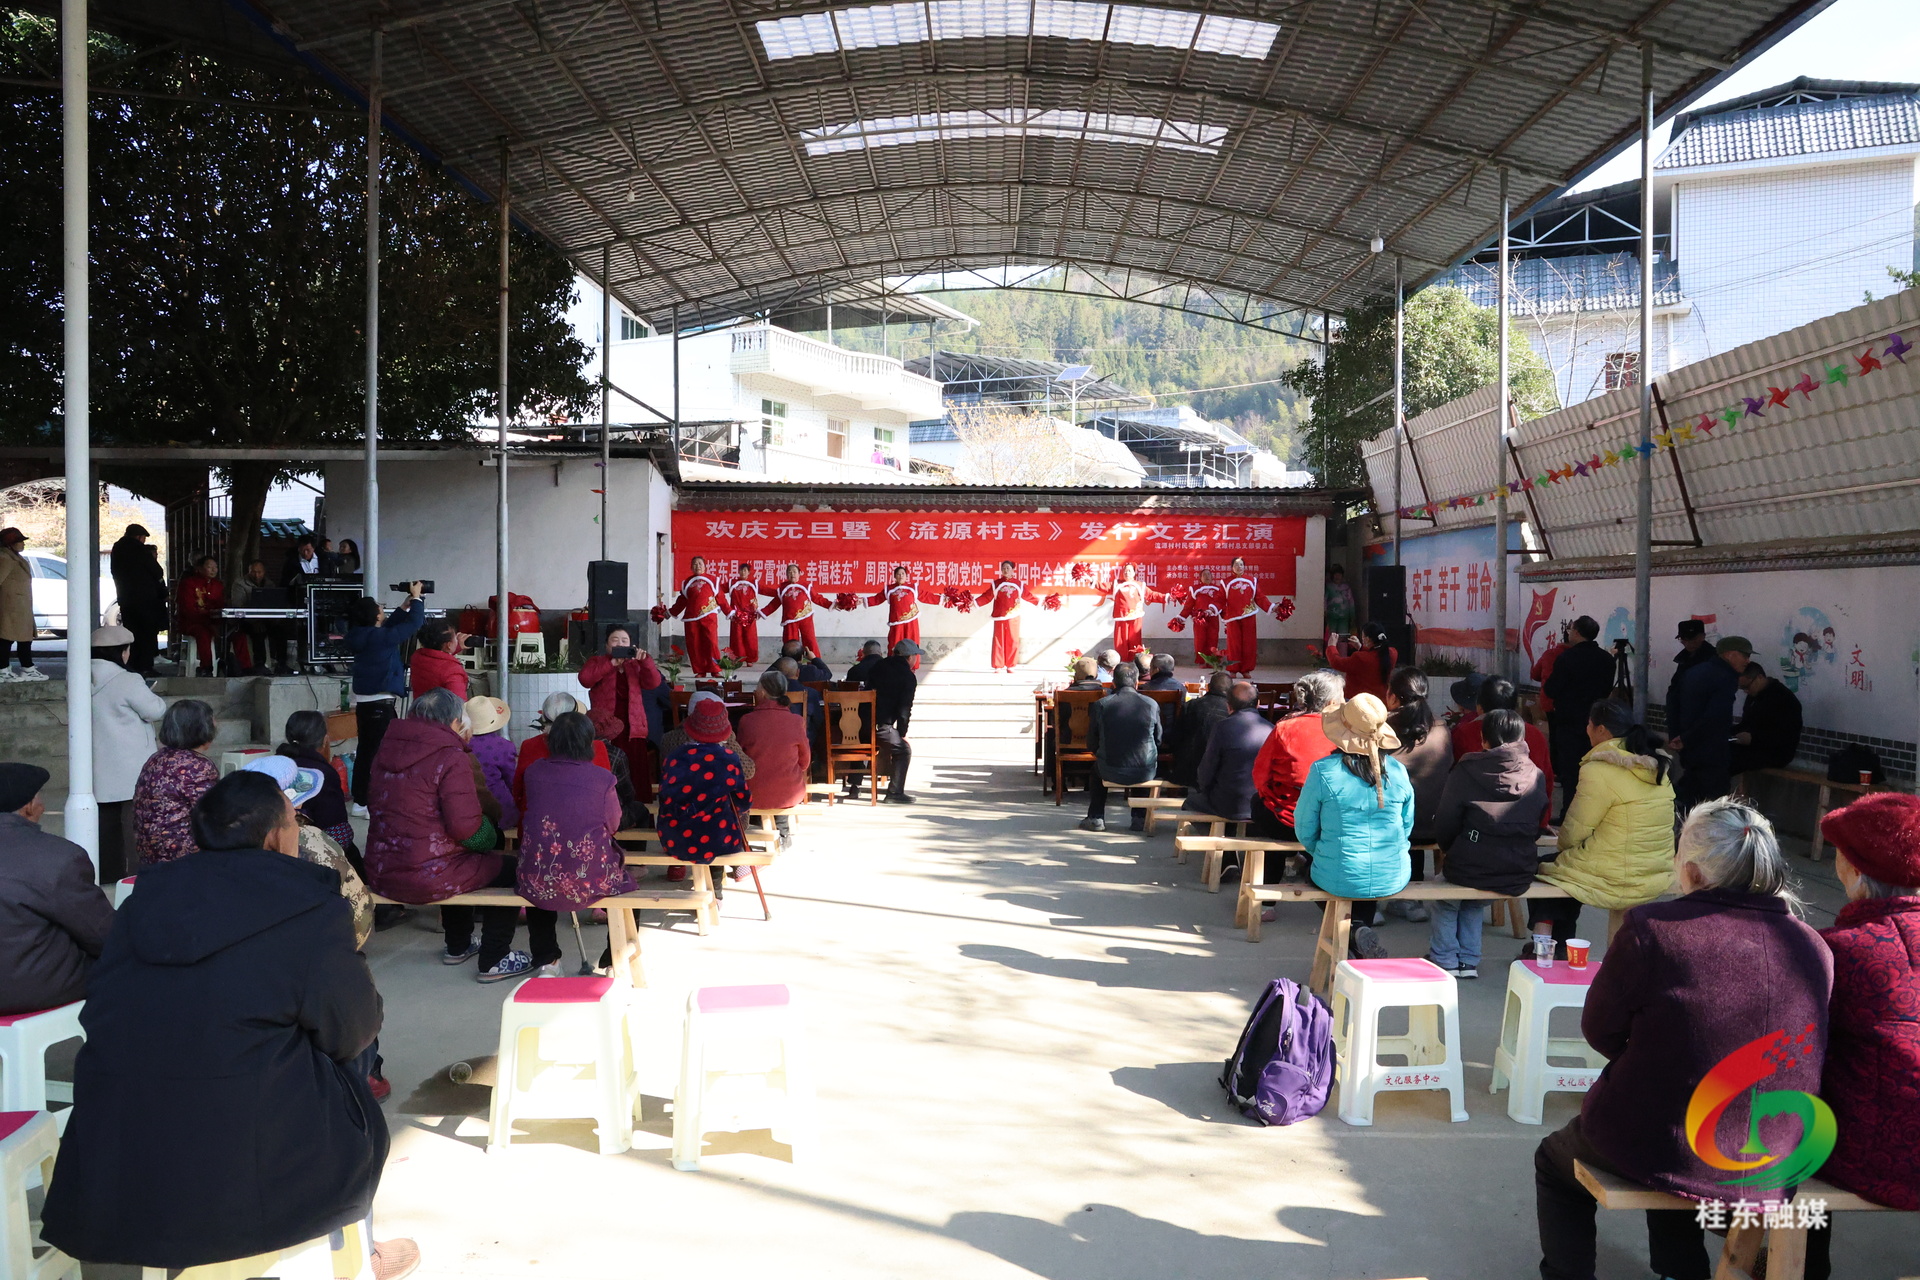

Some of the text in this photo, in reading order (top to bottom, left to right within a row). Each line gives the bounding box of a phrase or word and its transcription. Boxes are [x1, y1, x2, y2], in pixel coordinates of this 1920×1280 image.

[1438, 565, 1460, 612] 苦干
[1467, 561, 1496, 612] 拼命
[1850, 643, 1866, 691] 文明
[1384, 1073, 1440, 1086] 文化服务中心
